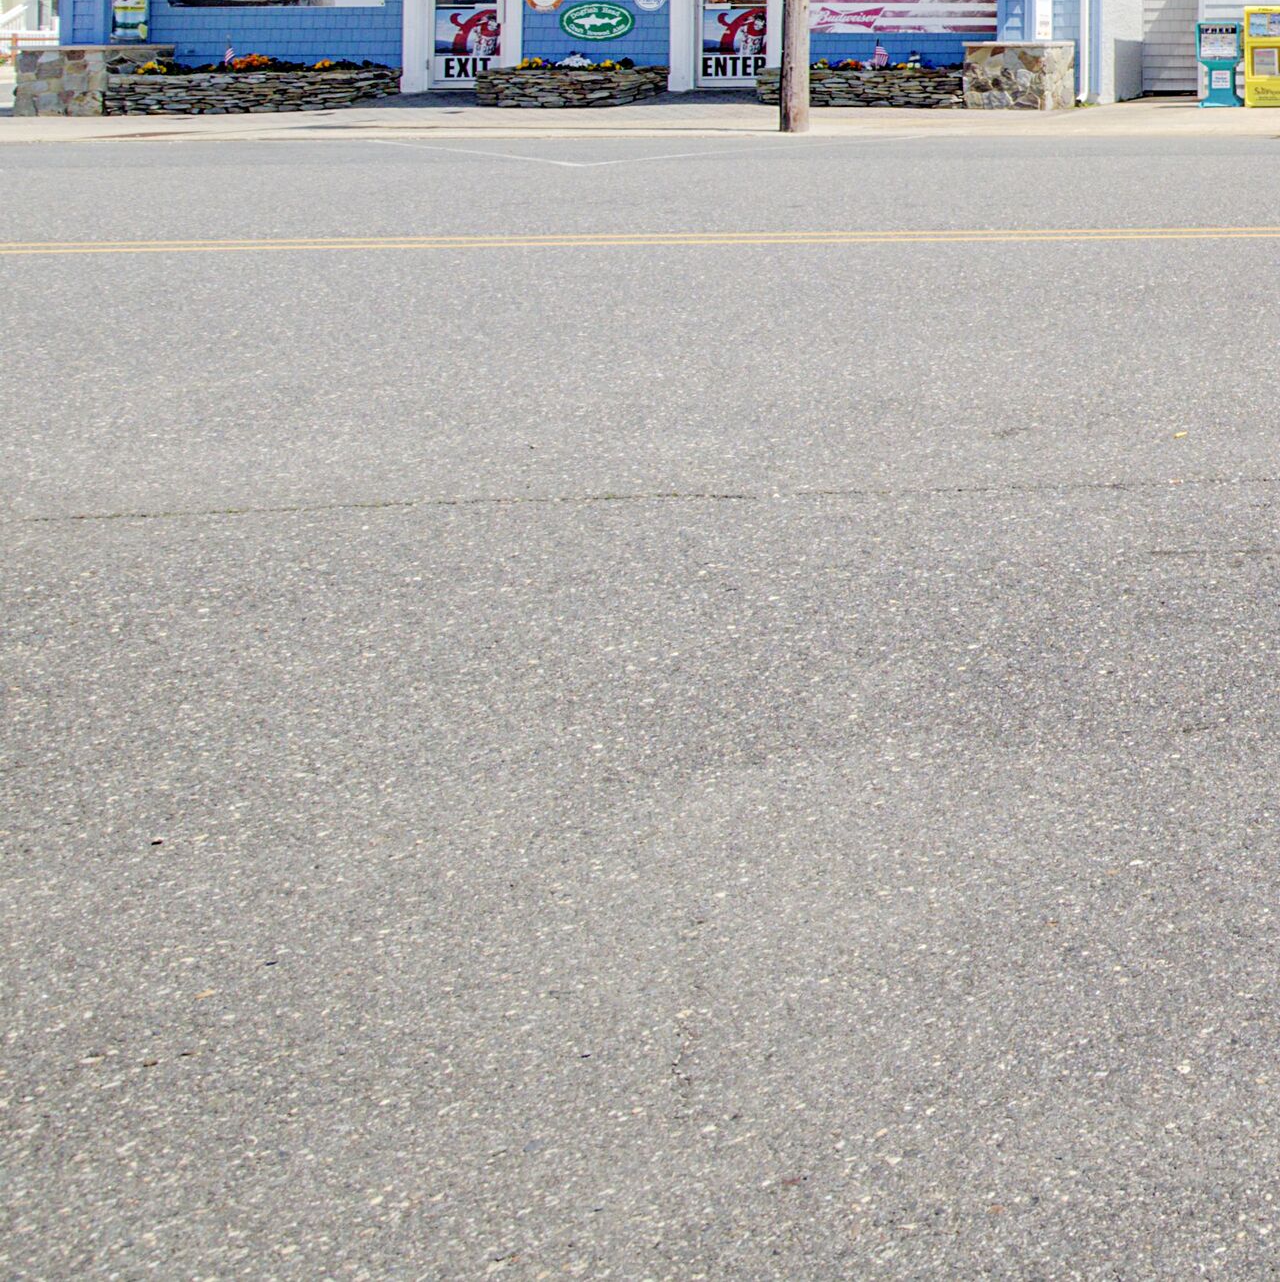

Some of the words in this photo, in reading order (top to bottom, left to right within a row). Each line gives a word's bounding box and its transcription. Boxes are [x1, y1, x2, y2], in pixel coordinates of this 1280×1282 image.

[570, 7, 599, 19] Dogfish
[601, 7, 621, 17] Head
[818, 9, 878, 24] Budweiser
[445, 57, 491, 78] EXIT
